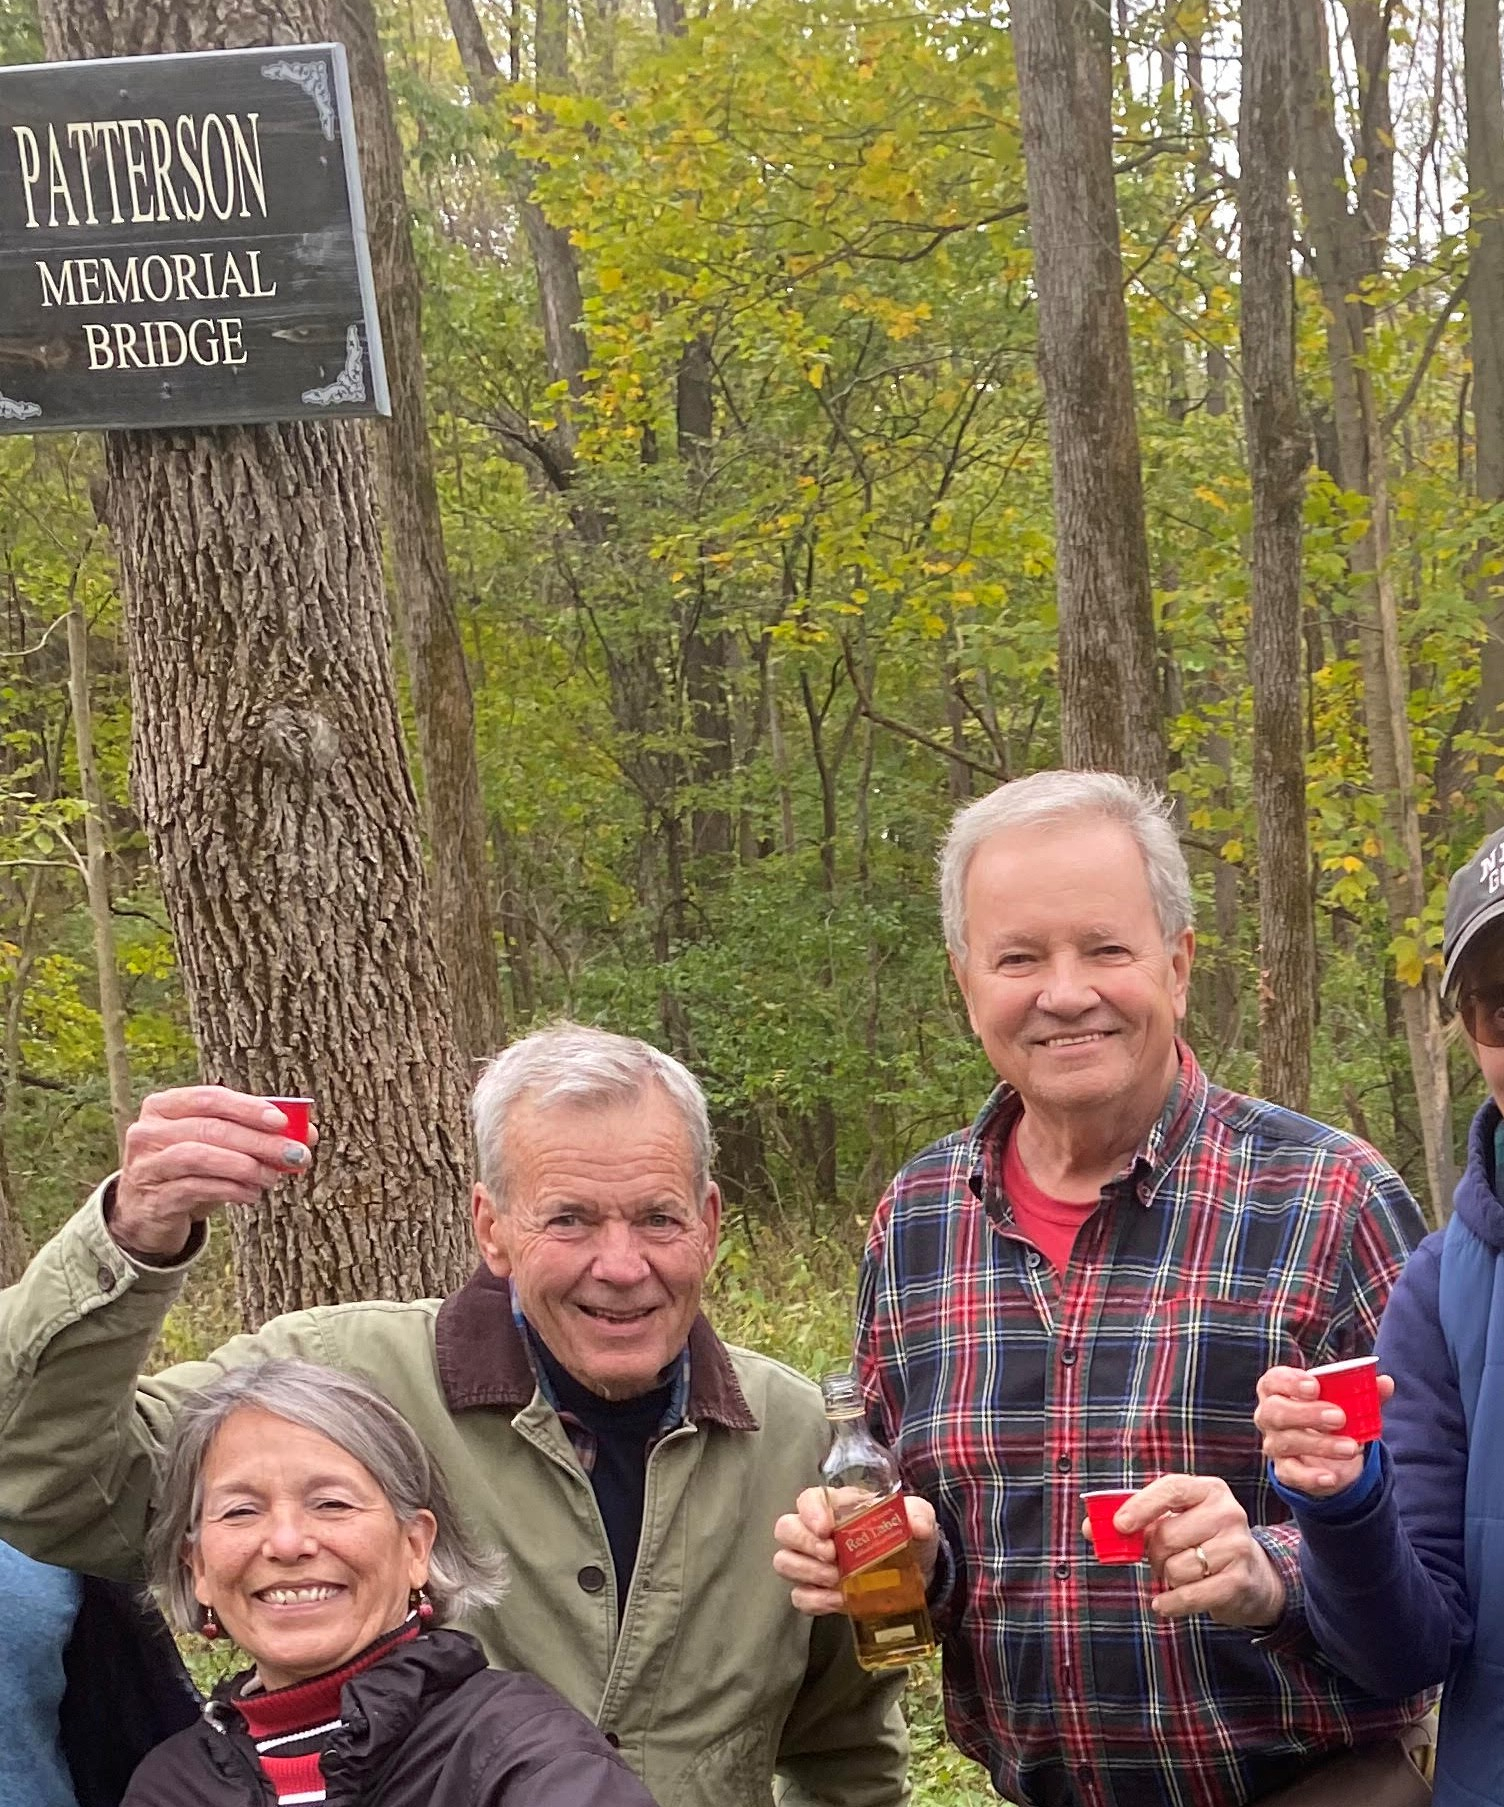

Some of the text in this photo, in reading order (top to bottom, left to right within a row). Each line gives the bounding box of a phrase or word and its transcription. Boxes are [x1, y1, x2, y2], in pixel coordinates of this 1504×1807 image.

[12, 113, 268, 228] PATTERSON
[36, 251, 276, 307] MEMORIAL
[82, 318, 248, 370] BRIDGE
[845, 1532, 870, 1552] Red
